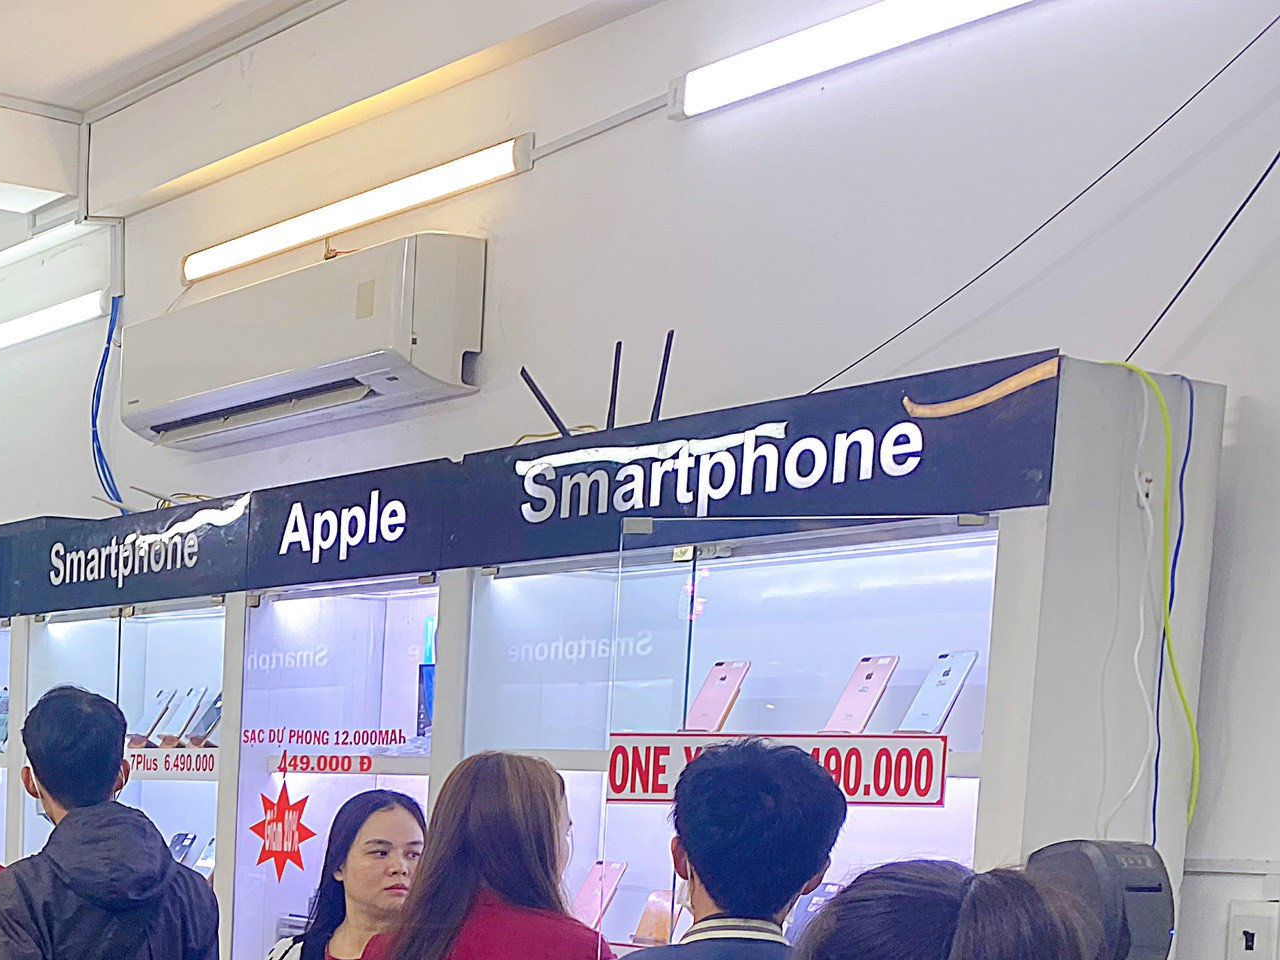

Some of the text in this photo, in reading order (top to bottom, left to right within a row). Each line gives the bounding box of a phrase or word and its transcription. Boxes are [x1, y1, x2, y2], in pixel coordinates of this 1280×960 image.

[520, 420, 923, 523] Smartphone
[279, 490, 406, 563] Apple
[50, 530, 199, 588] Smartphone
[130, 753, 215, 772] 7Plus 6.490.000
[242, 728, 265, 748] SẠC
[288, 729, 330, 745] PHONG
